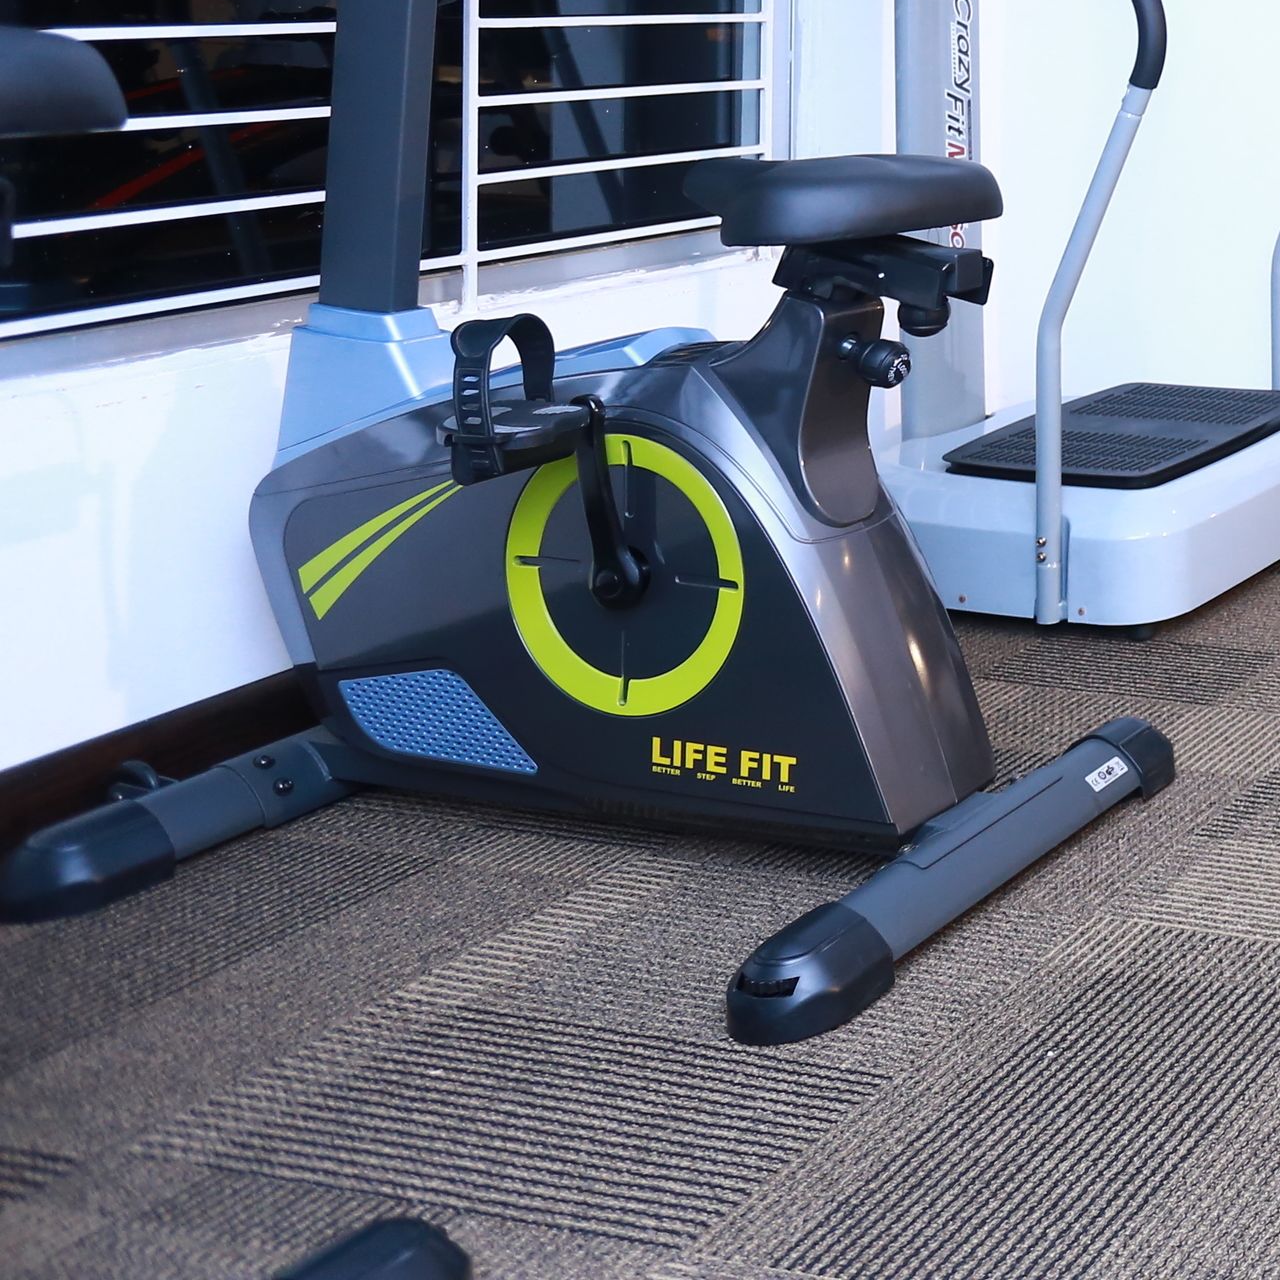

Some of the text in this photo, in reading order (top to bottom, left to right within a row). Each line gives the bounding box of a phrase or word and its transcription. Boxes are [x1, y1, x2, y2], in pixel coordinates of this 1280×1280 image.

[652, 736, 797, 783] LIFE FIT
[652, 765, 796, 793] BETTER STEP BETTER LIFE
